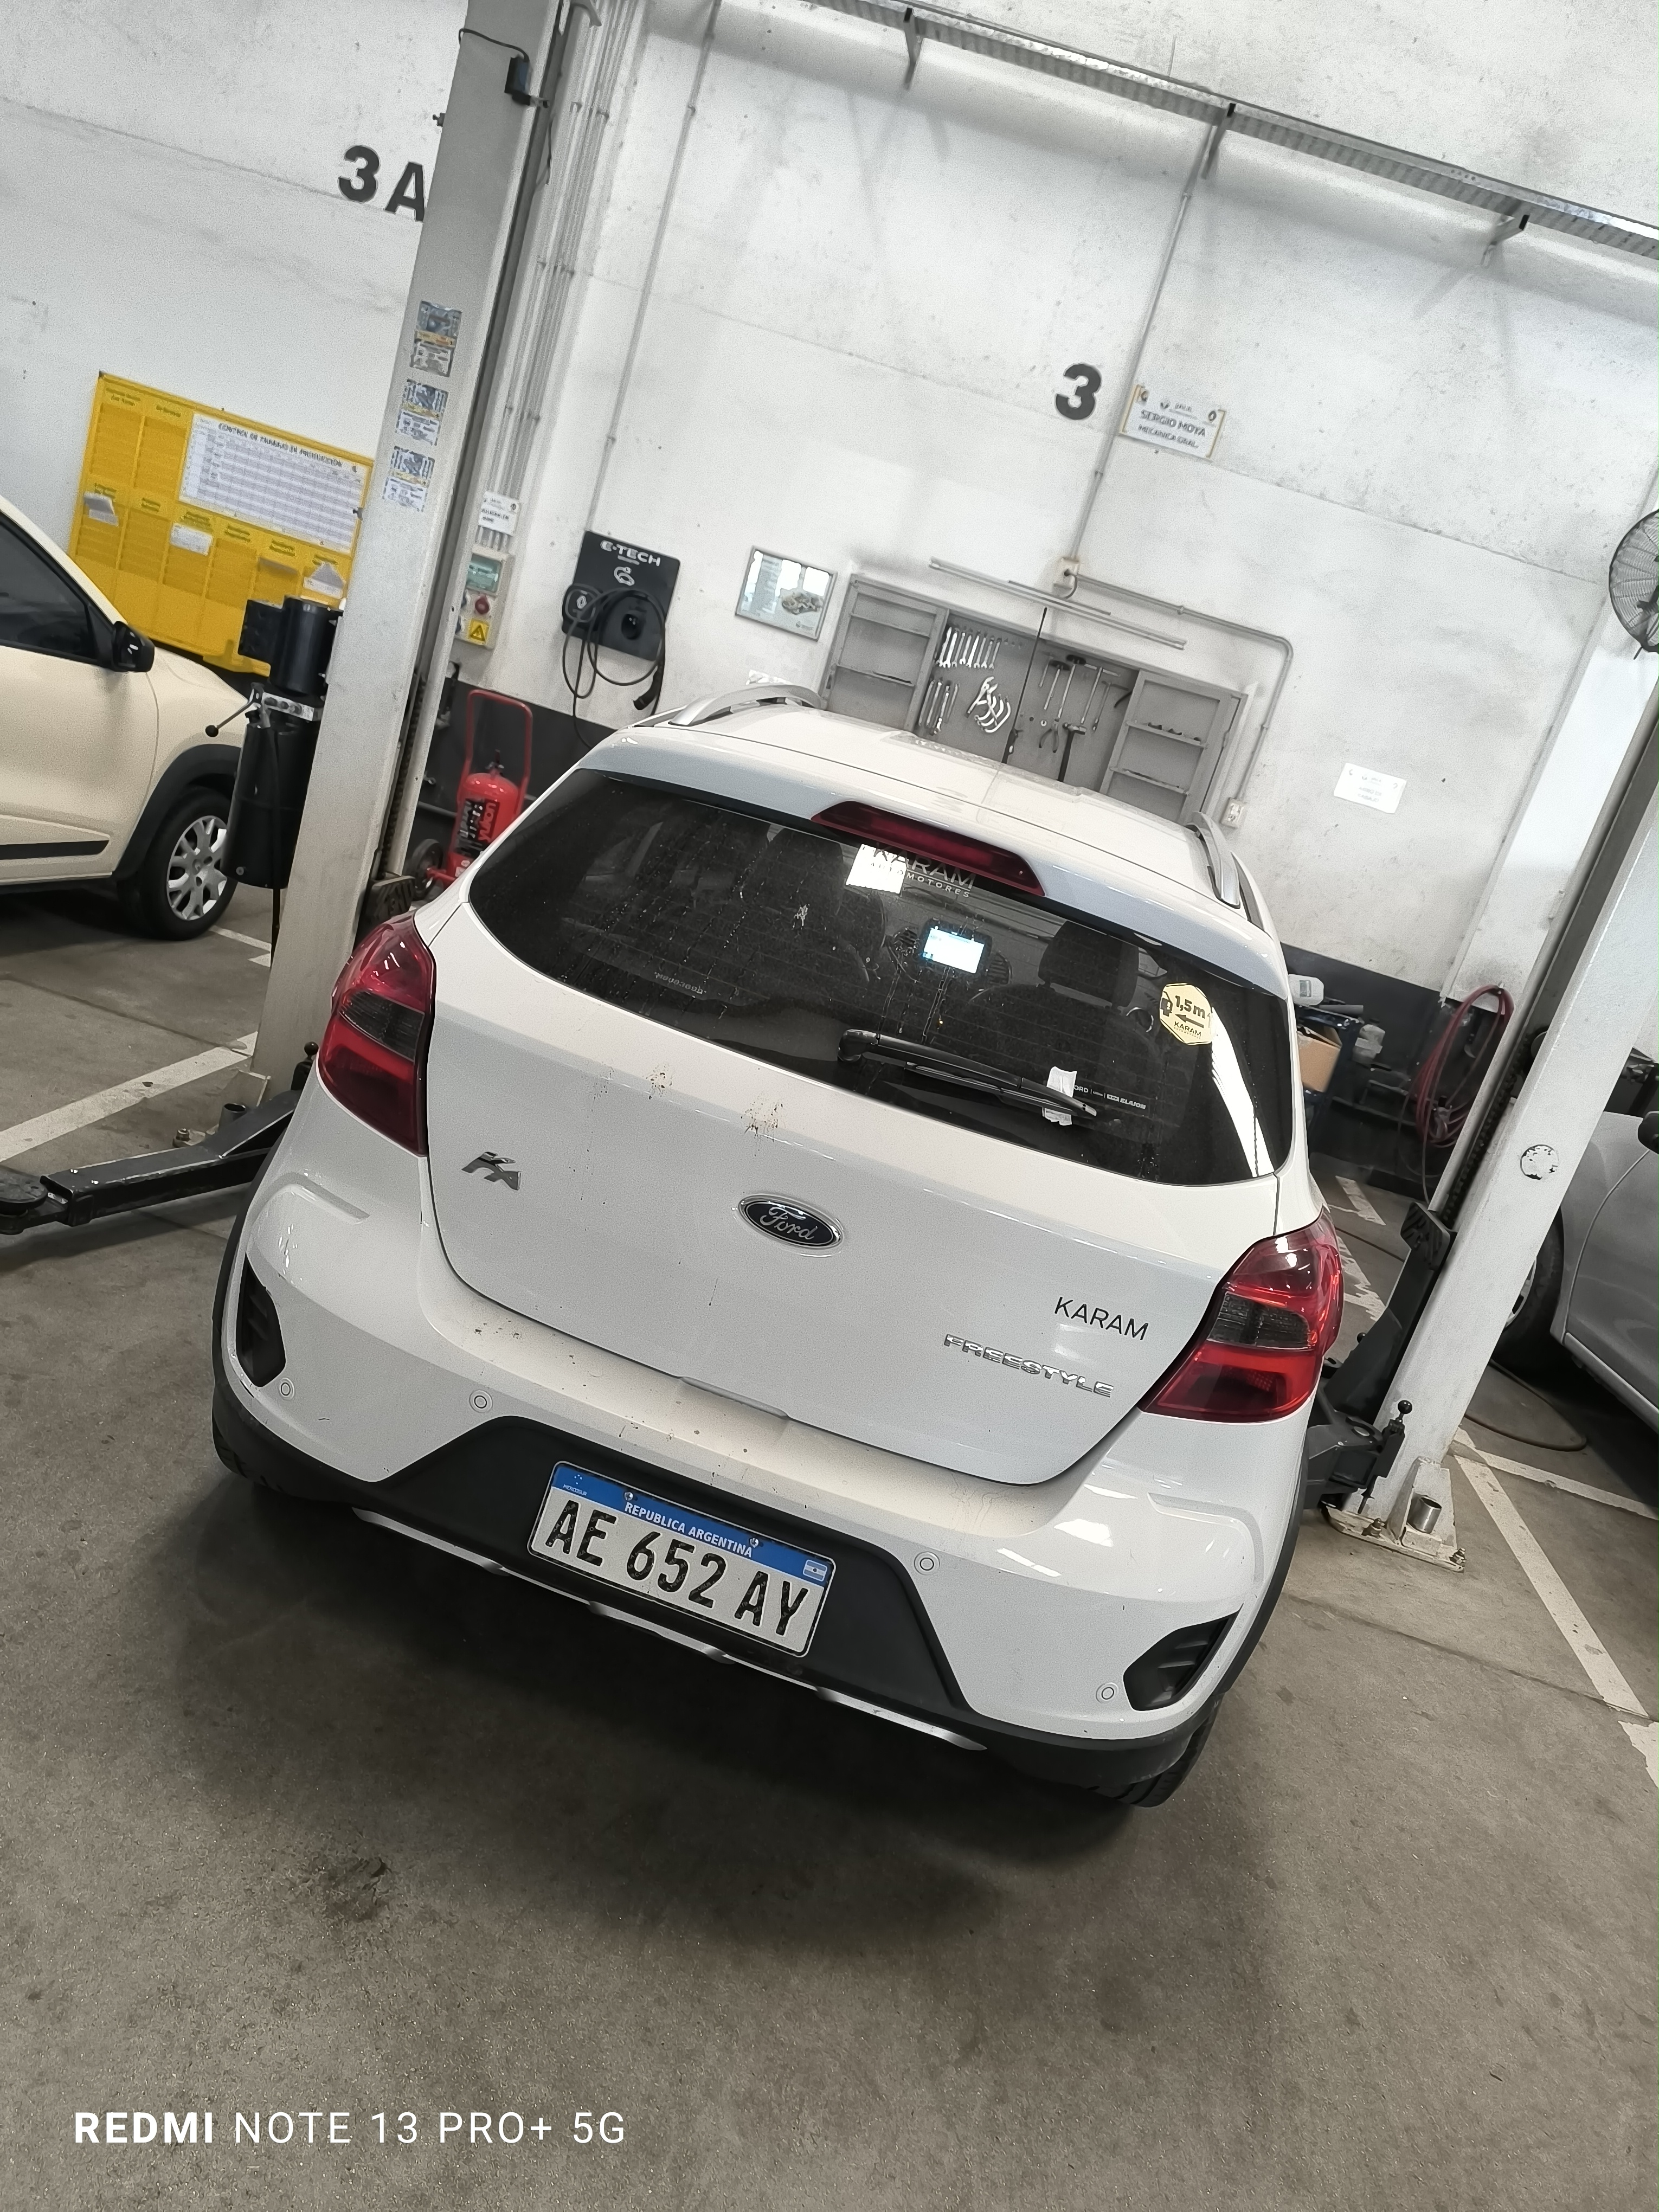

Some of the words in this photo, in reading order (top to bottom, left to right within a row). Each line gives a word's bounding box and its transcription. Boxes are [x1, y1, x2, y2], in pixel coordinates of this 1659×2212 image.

[1054, 362, 1103, 421] 3
[600, 540, 661, 567] E-TECH
[1174, 1021, 1201, 1037] KARAM
[1073, 1085, 1089, 1093] ORD
[760, 1206, 818, 1240] Ford
[1054, 1296, 1149, 1341] KARAM
[943, 1334, 1114, 1398] FREESTYLE
[624, 1501, 686, 1534] REPUBLICA
[688, 1526, 753, 1558] ARGENTINA
[544, 1499, 618, 1567] AE
[626, 1531, 726, 1609] 652
[734, 1571, 809, 1636] AY
